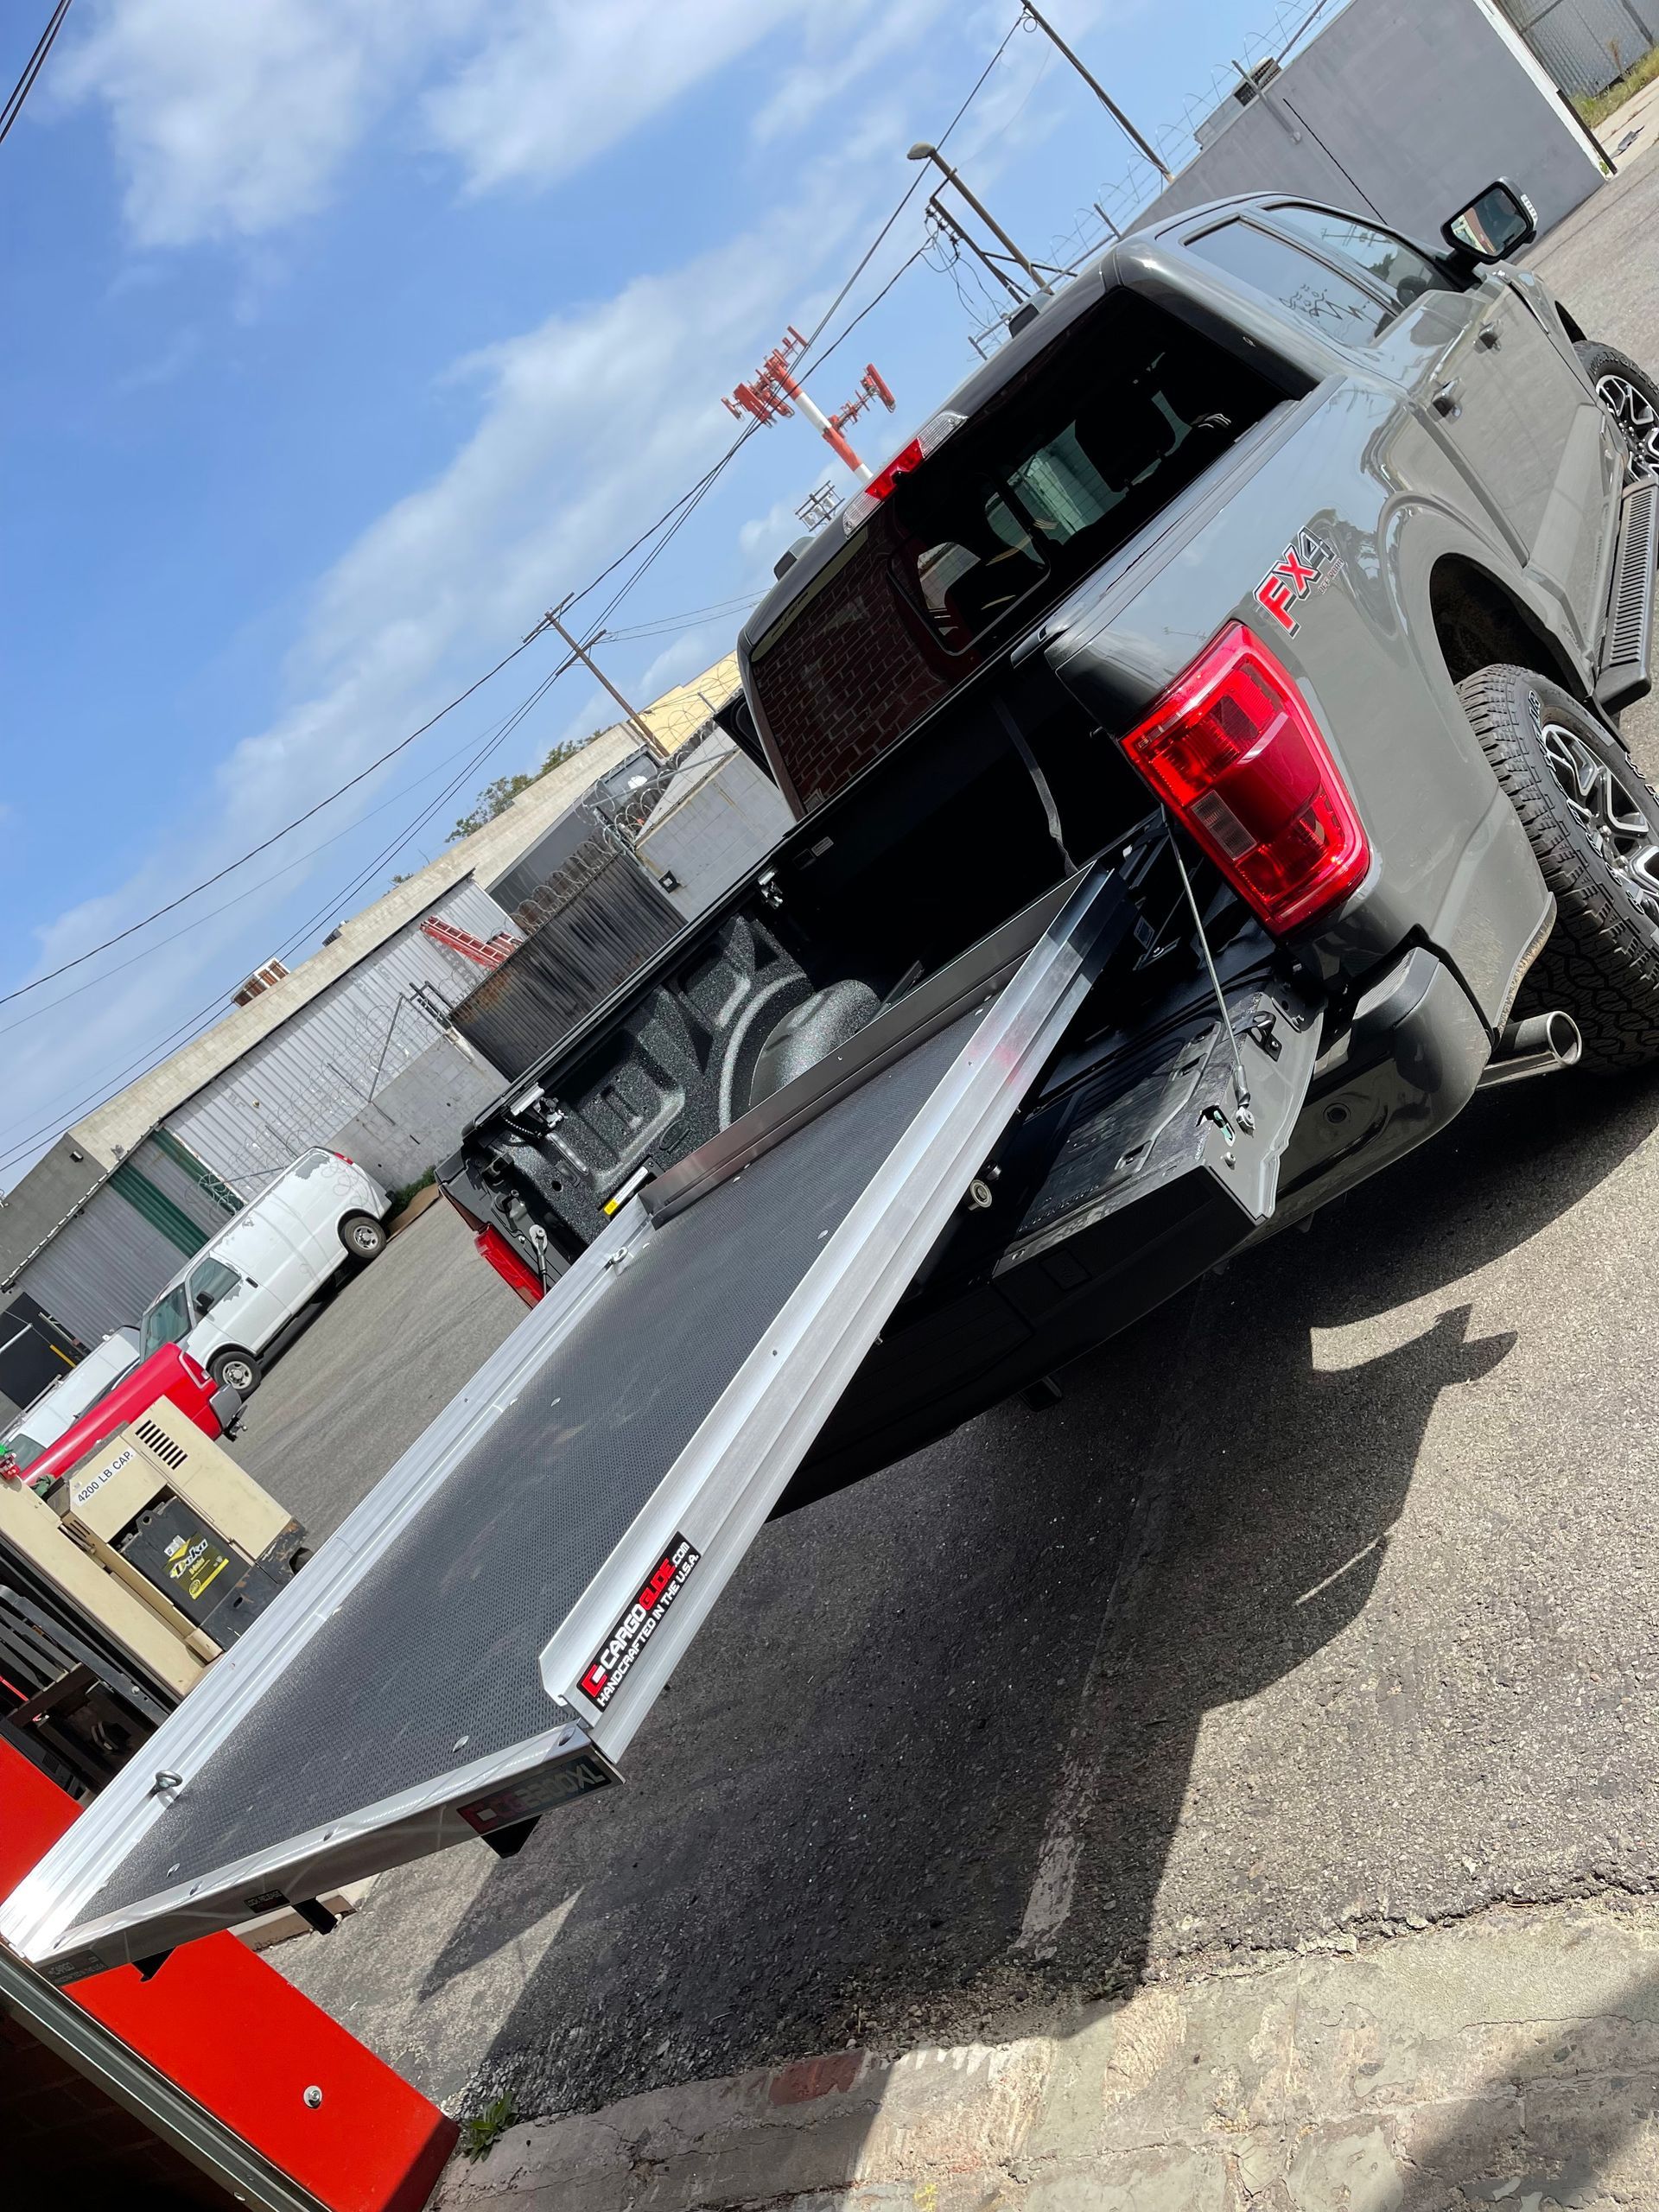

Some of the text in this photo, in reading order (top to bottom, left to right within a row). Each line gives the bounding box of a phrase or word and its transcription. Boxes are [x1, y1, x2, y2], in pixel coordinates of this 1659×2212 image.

[1253, 525, 1338, 639] FX4
[78, 1482, 99, 1502] 4200
[98, 1469, 112, 1484] LB
[596, 1554, 699, 1707] HANDCRAFTED IN THE U.S.A.
